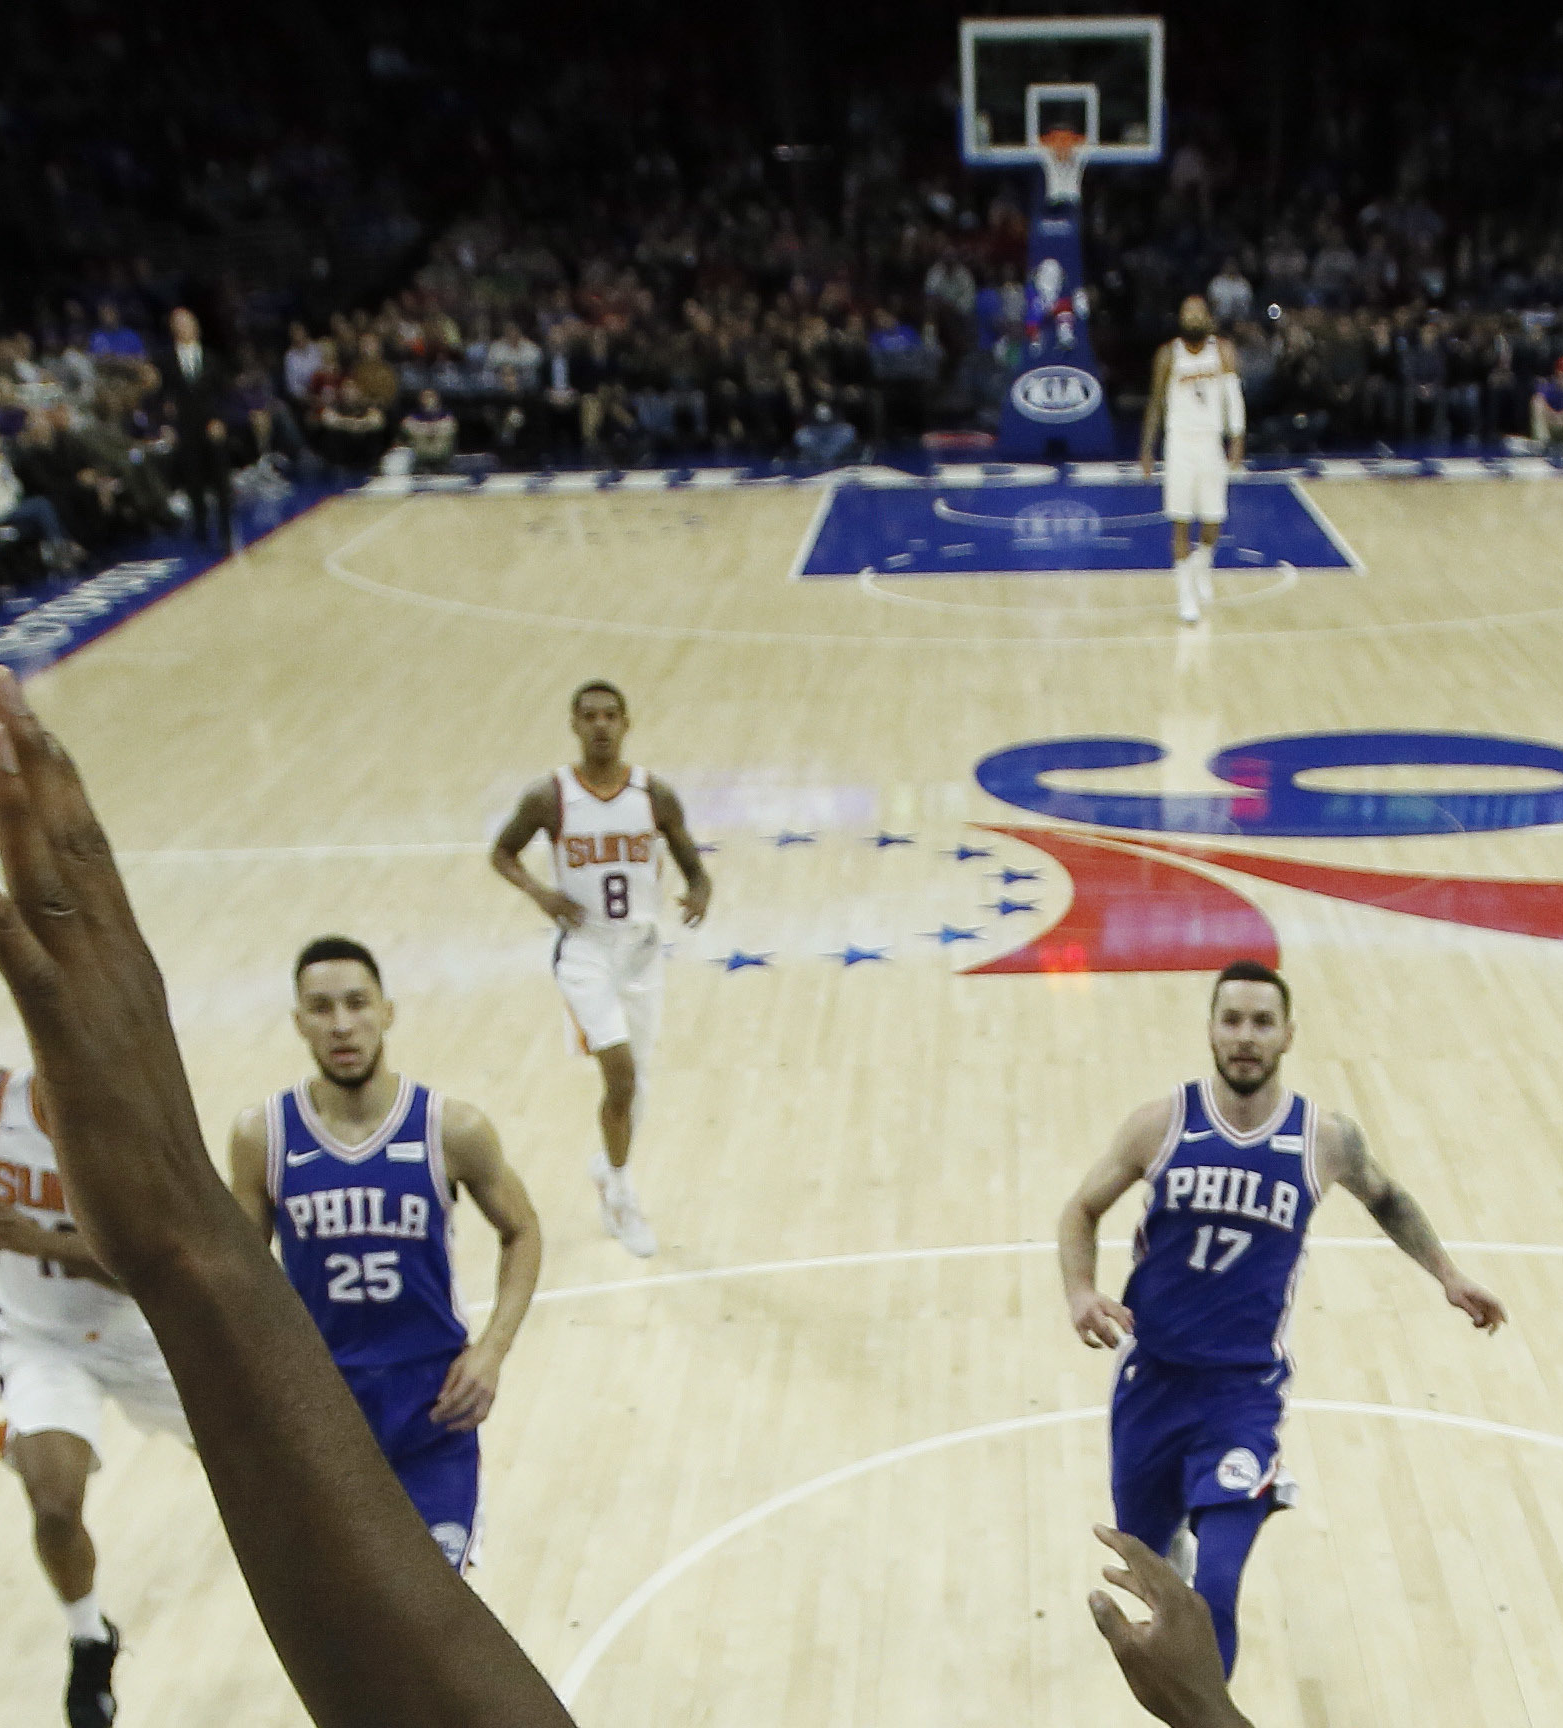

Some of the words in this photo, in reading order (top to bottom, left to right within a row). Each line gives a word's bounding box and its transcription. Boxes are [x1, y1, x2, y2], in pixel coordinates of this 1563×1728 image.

[564, 832, 655, 868] SUNS
[603, 872, 629, 920] 8
[284, 1186, 431, 1242] PHILA
[1167, 1166, 1300, 1230] PHILA
[1188, 1225, 1253, 1273] 17
[324, 1249, 406, 1304] 25
